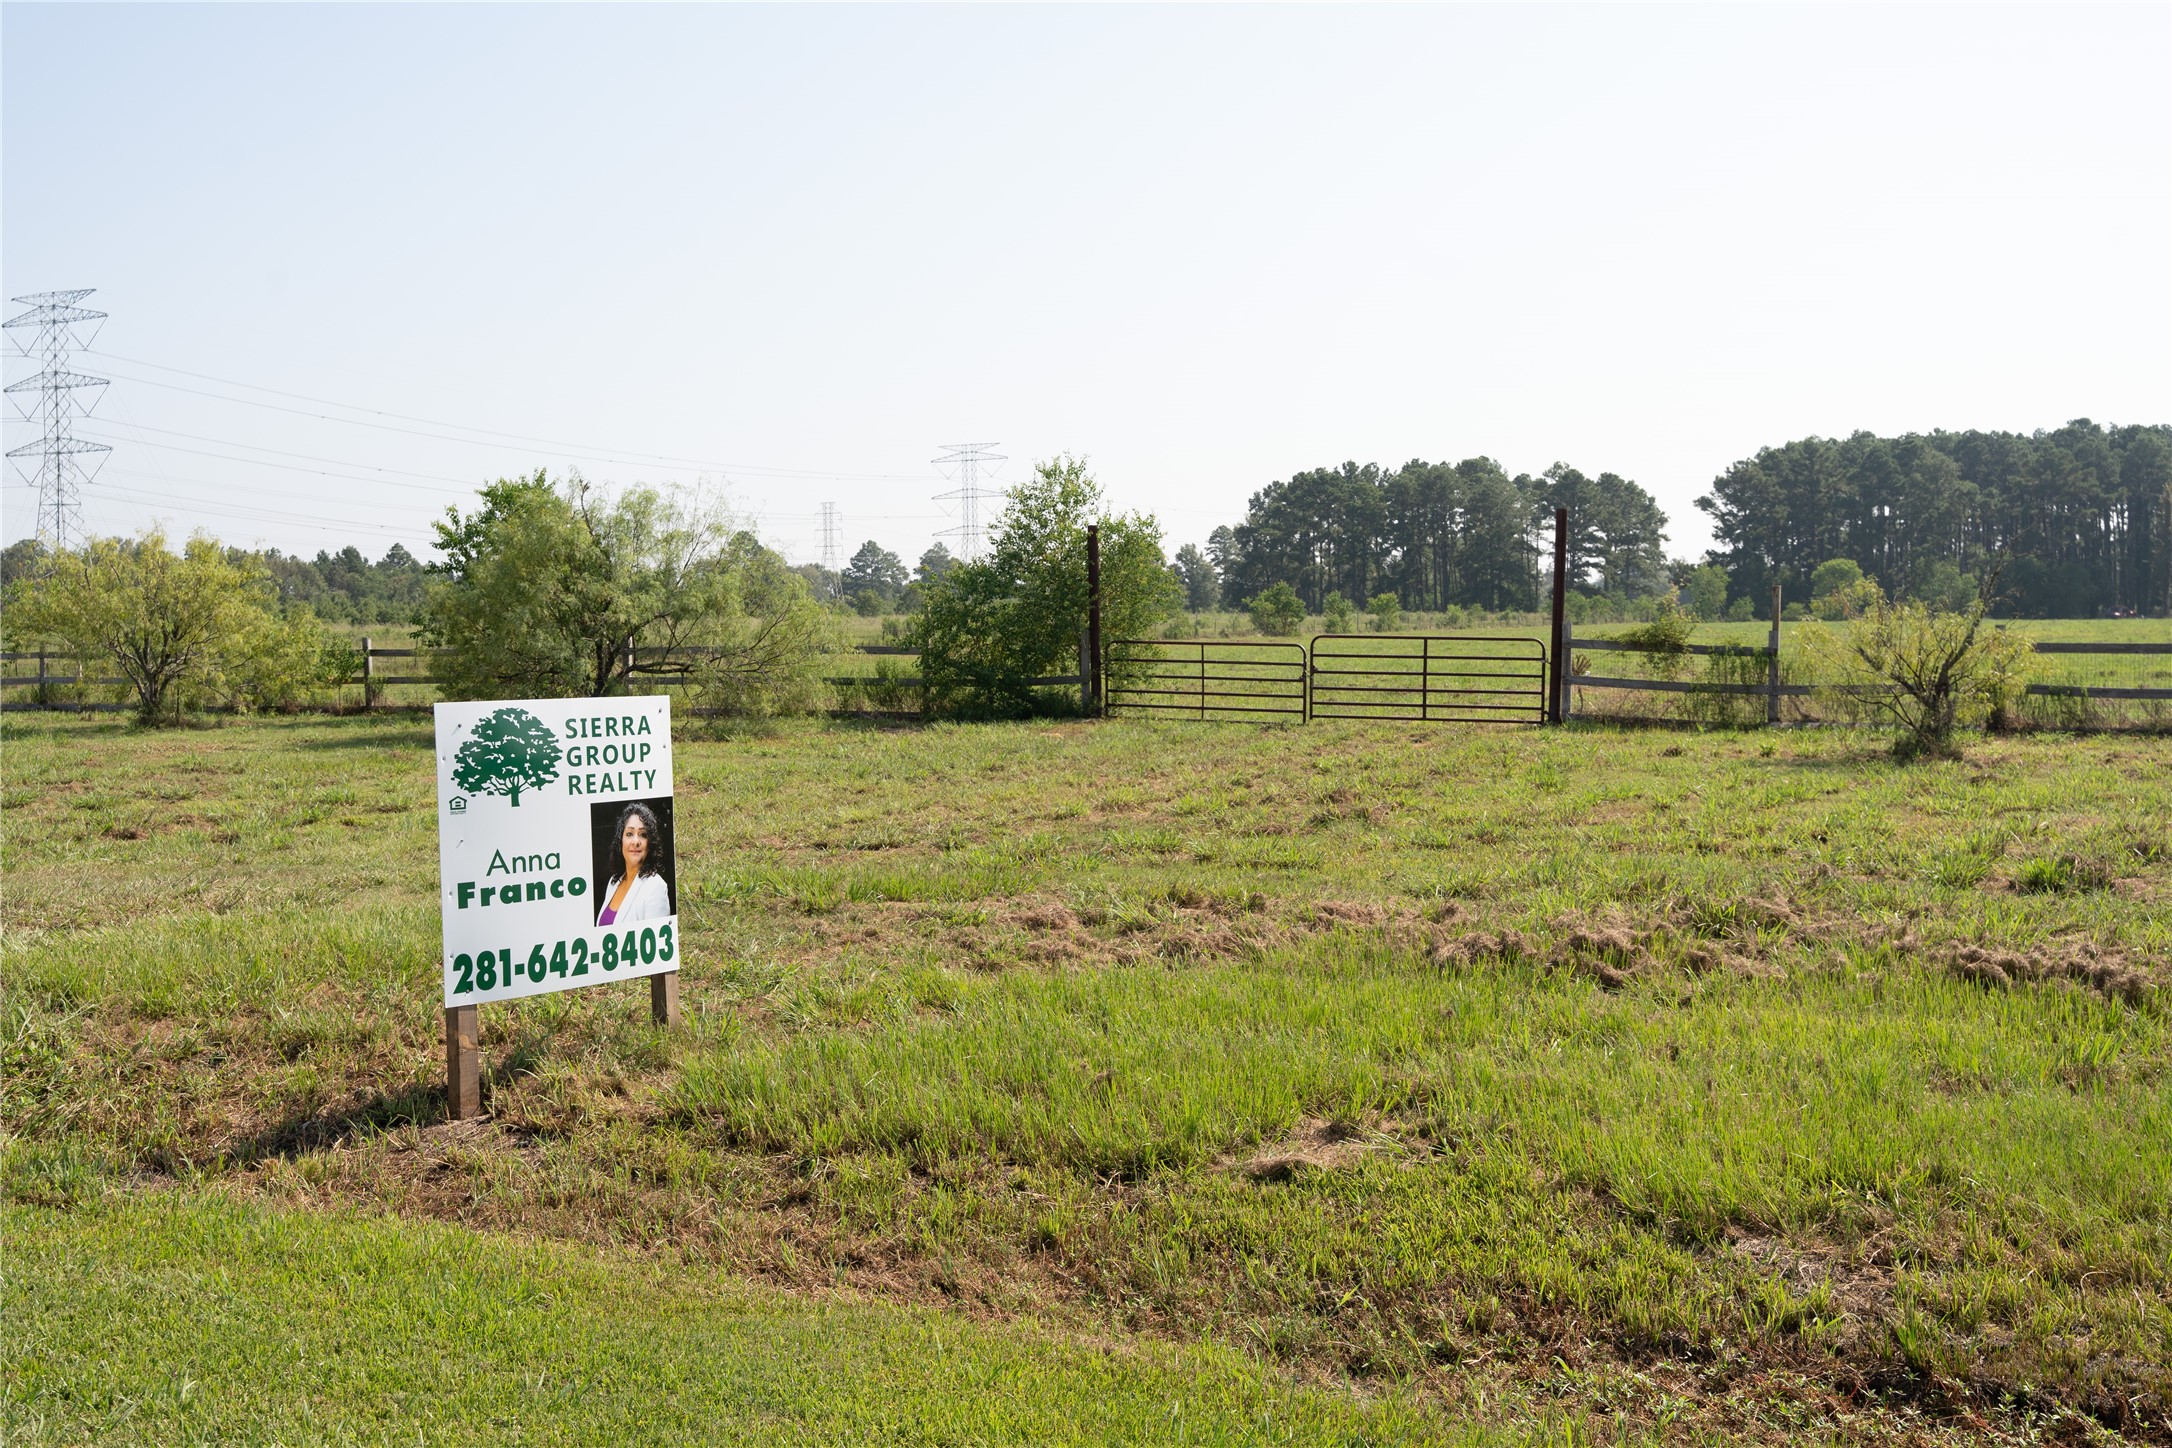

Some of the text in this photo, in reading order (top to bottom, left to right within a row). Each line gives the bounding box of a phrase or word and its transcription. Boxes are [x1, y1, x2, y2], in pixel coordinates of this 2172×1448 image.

[565, 715, 652, 739] SIERRA
[566, 742, 651, 767] GROUP
[568, 769, 657, 795] REALTY
[486, 848, 561, 877] Anna
[457, 876, 587, 909] Franco
[453, 924, 674, 995] 281-642-8403
